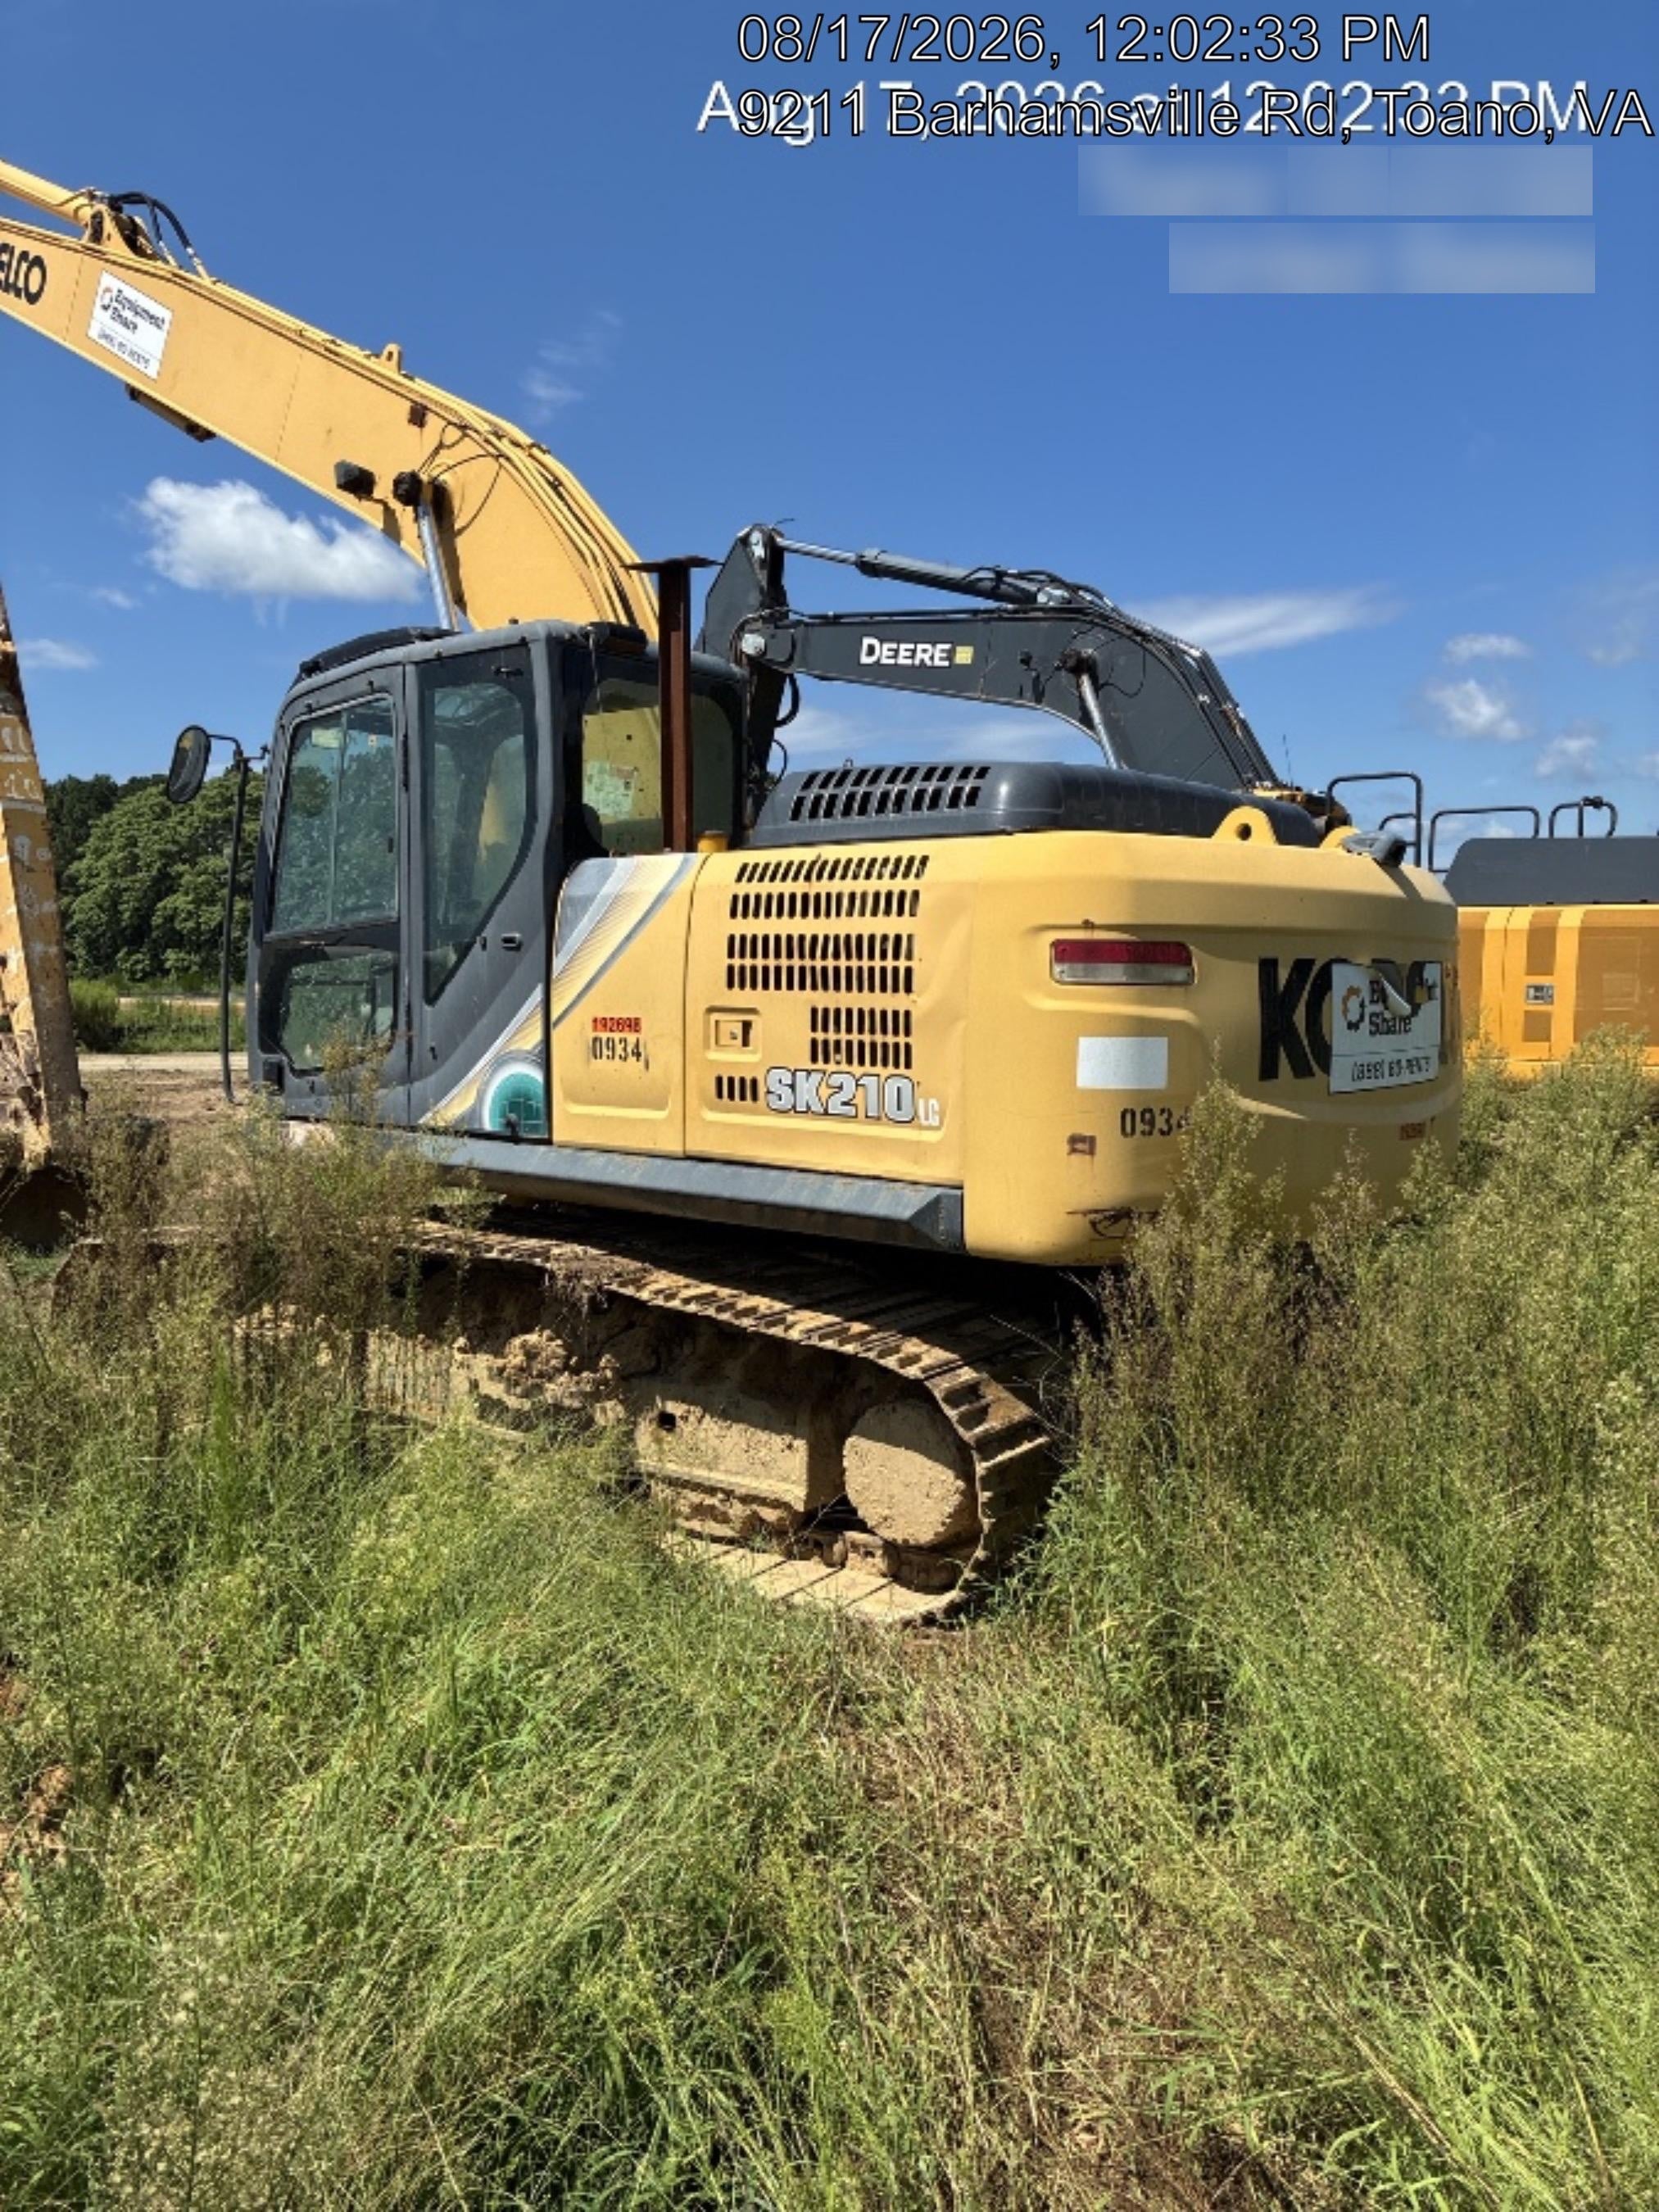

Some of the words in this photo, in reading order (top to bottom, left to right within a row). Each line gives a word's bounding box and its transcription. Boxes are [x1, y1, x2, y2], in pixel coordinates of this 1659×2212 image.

[859, 635, 952, 668] DEERE
[1369, 1013, 1412, 1036] Share
[592, 1036, 642, 1063] 0934
[765, 1066, 917, 1124] SK210
